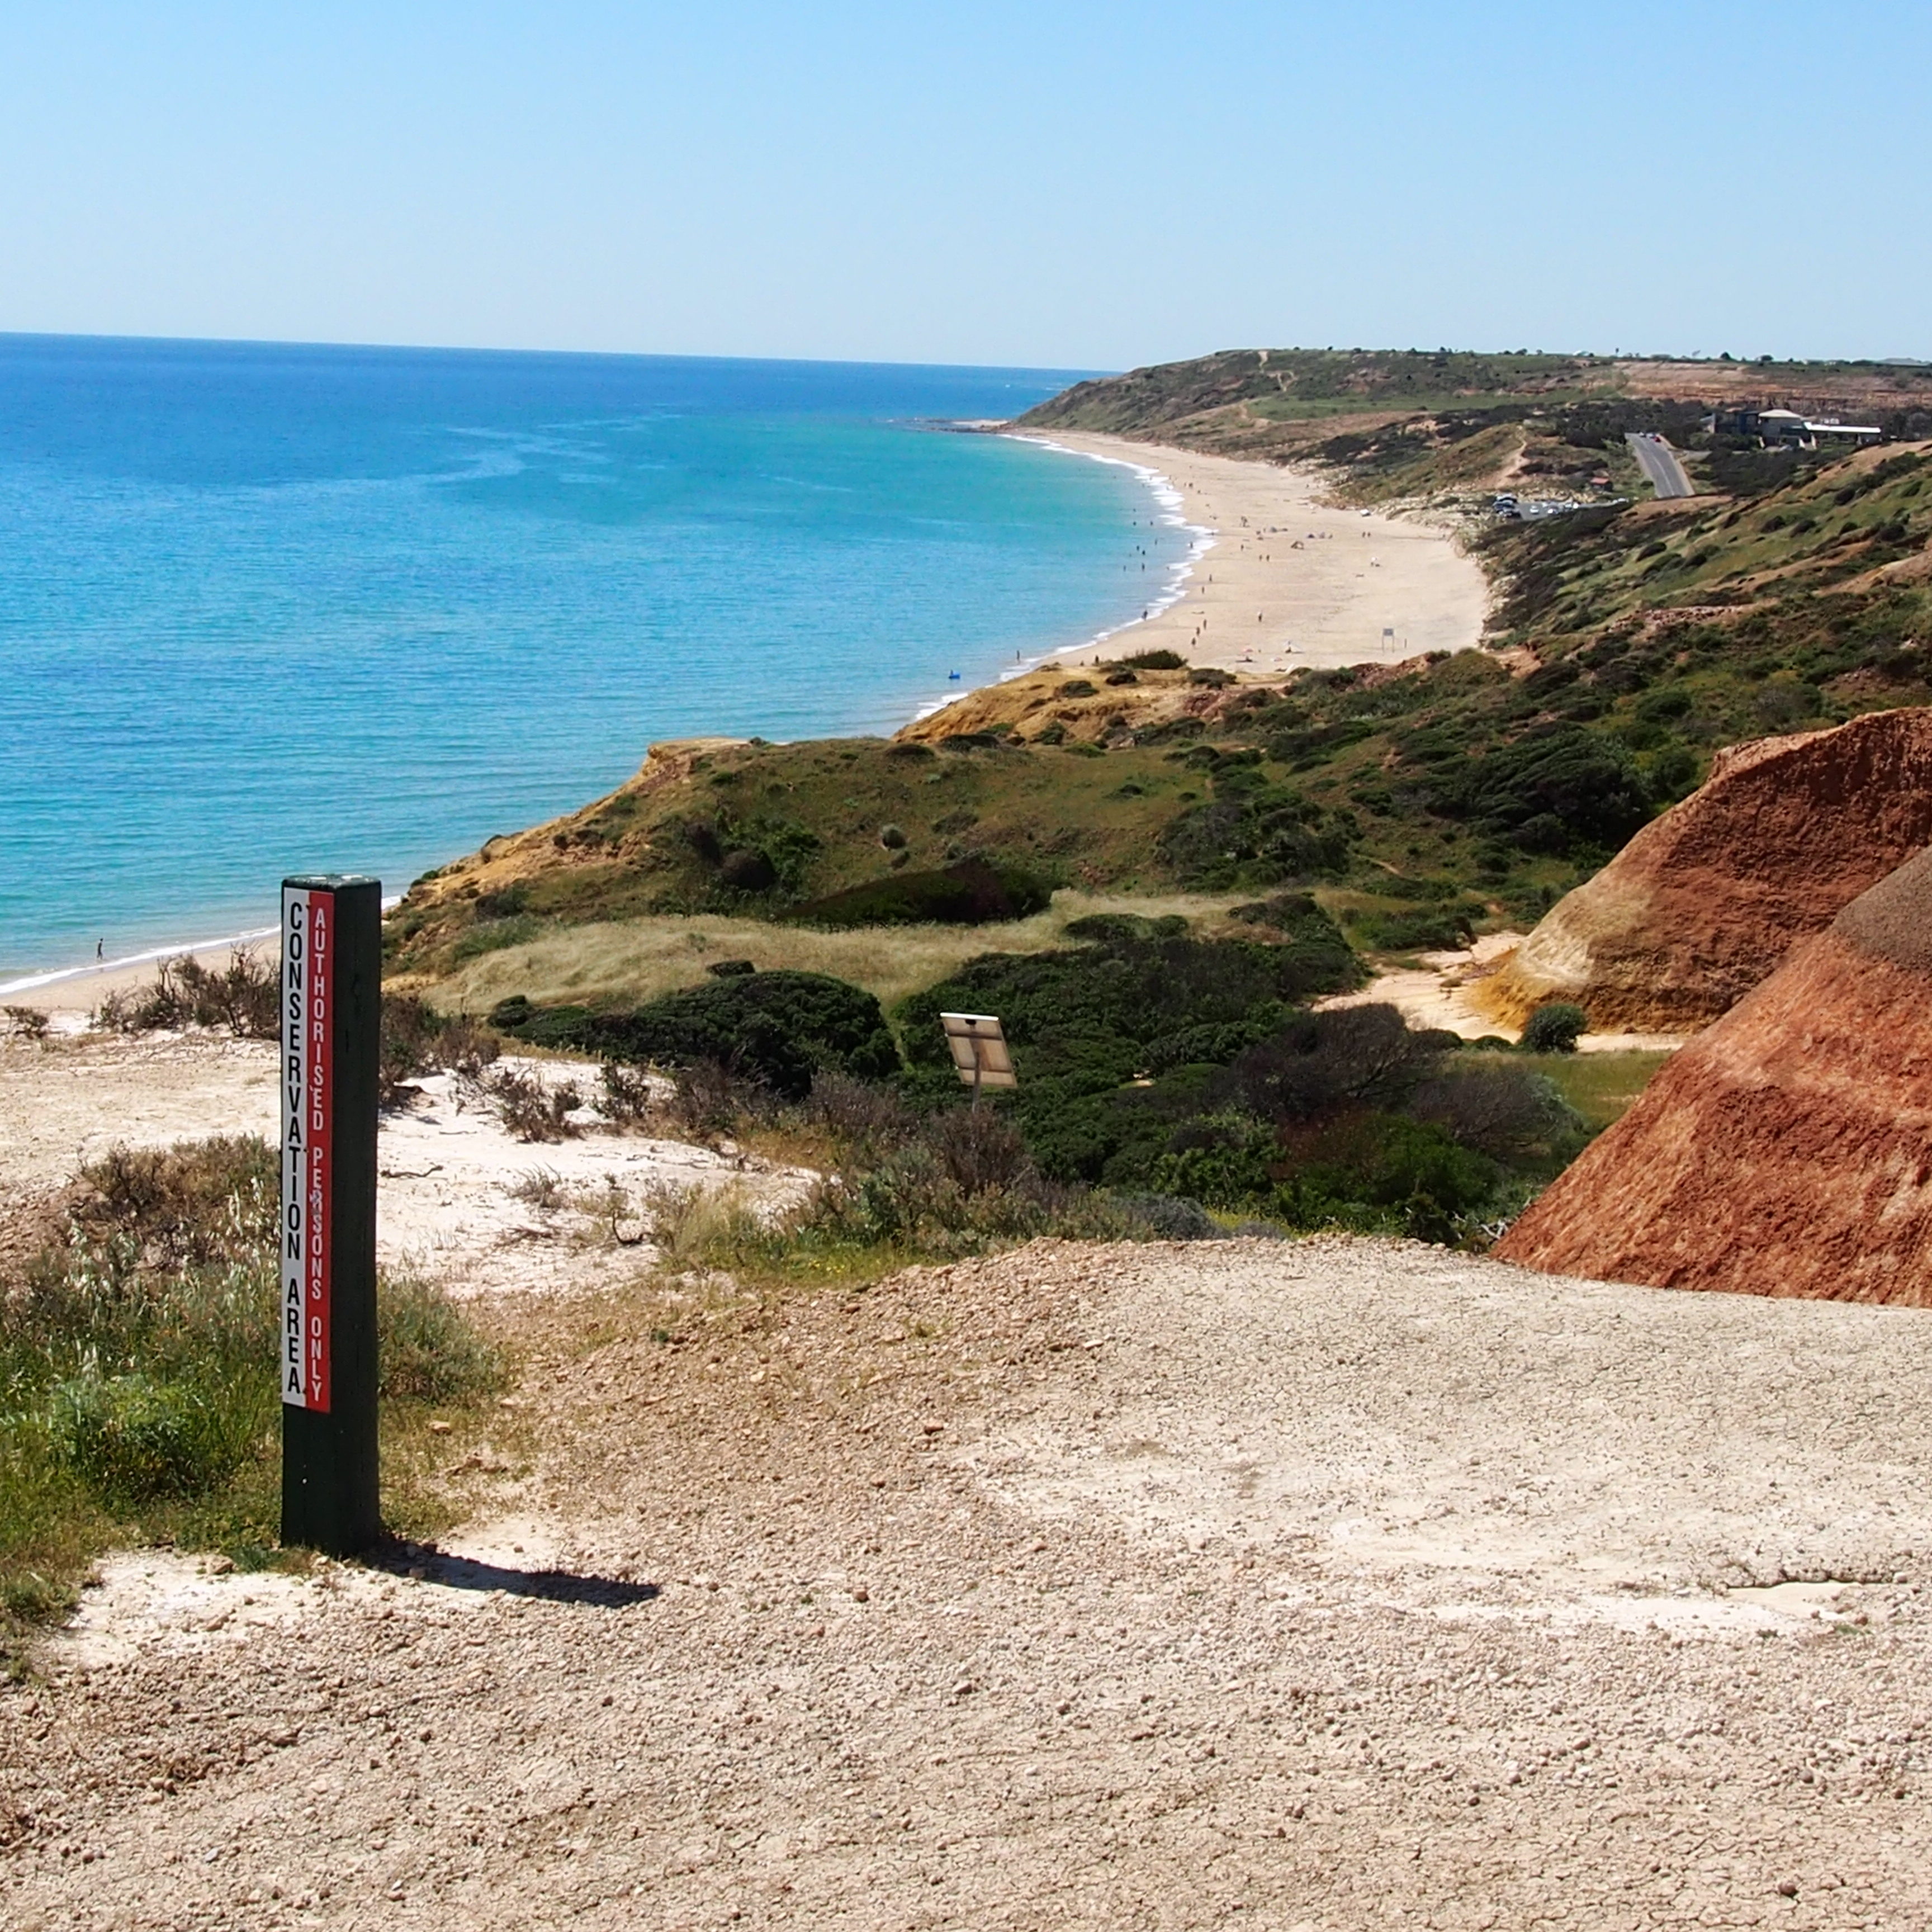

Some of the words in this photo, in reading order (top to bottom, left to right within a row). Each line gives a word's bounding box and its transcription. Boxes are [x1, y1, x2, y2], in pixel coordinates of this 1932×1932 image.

[288, 902, 302, 1259] CONSERVATION
[313, 908, 325, 1130] AUTHORISED
[311, 1147, 323, 1300] PERSONS
[287, 1278, 301, 1394] AREA
[311, 1316, 321, 1402] ONLY
